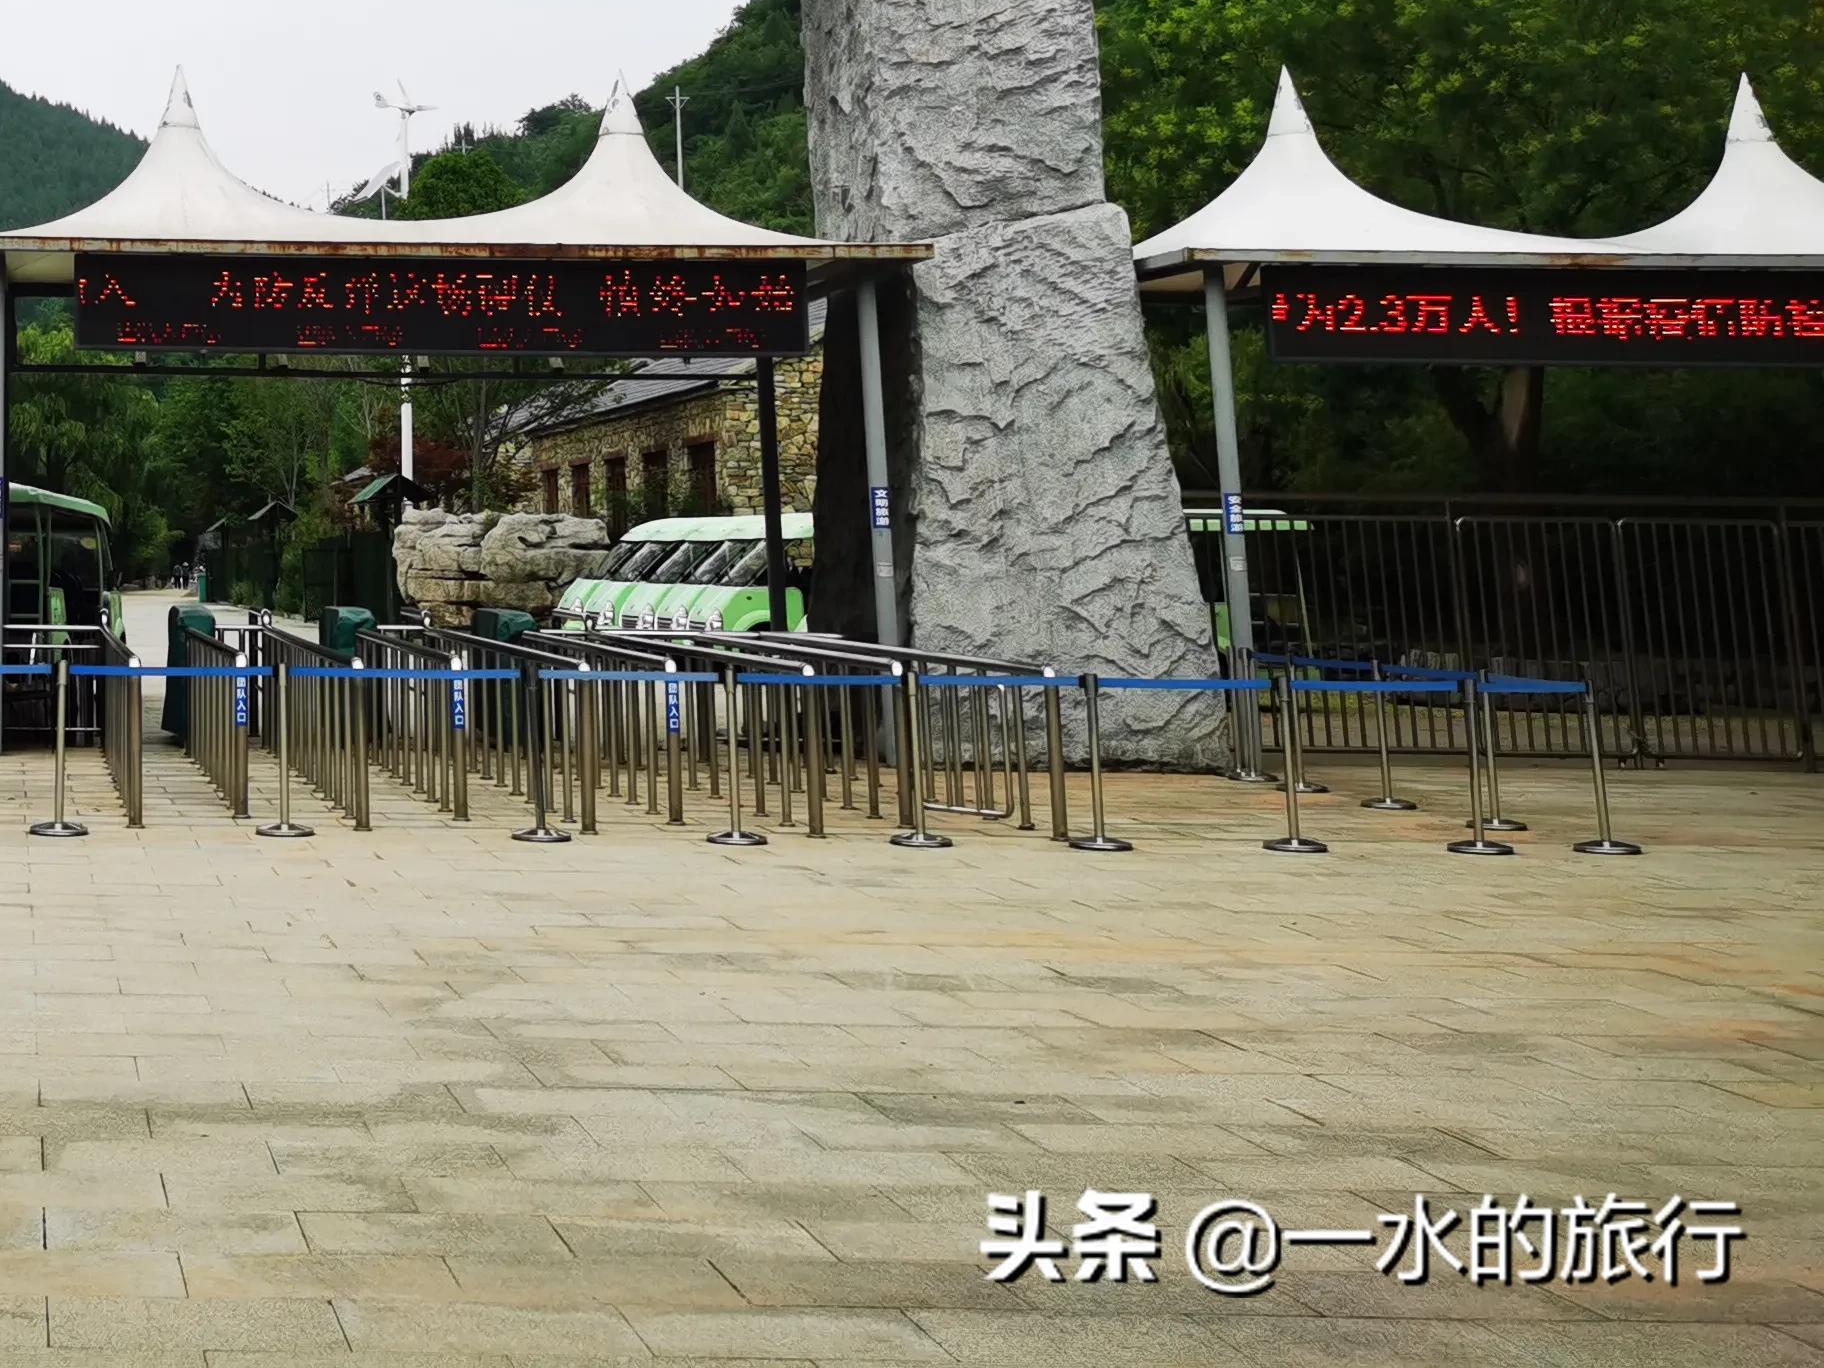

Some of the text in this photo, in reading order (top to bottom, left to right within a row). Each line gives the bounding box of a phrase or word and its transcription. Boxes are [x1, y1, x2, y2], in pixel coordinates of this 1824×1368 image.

[236, 676, 247, 723] 团队入口
[453, 679, 464, 725] 团队入口
[668, 682, 679, 729] 团队入口
